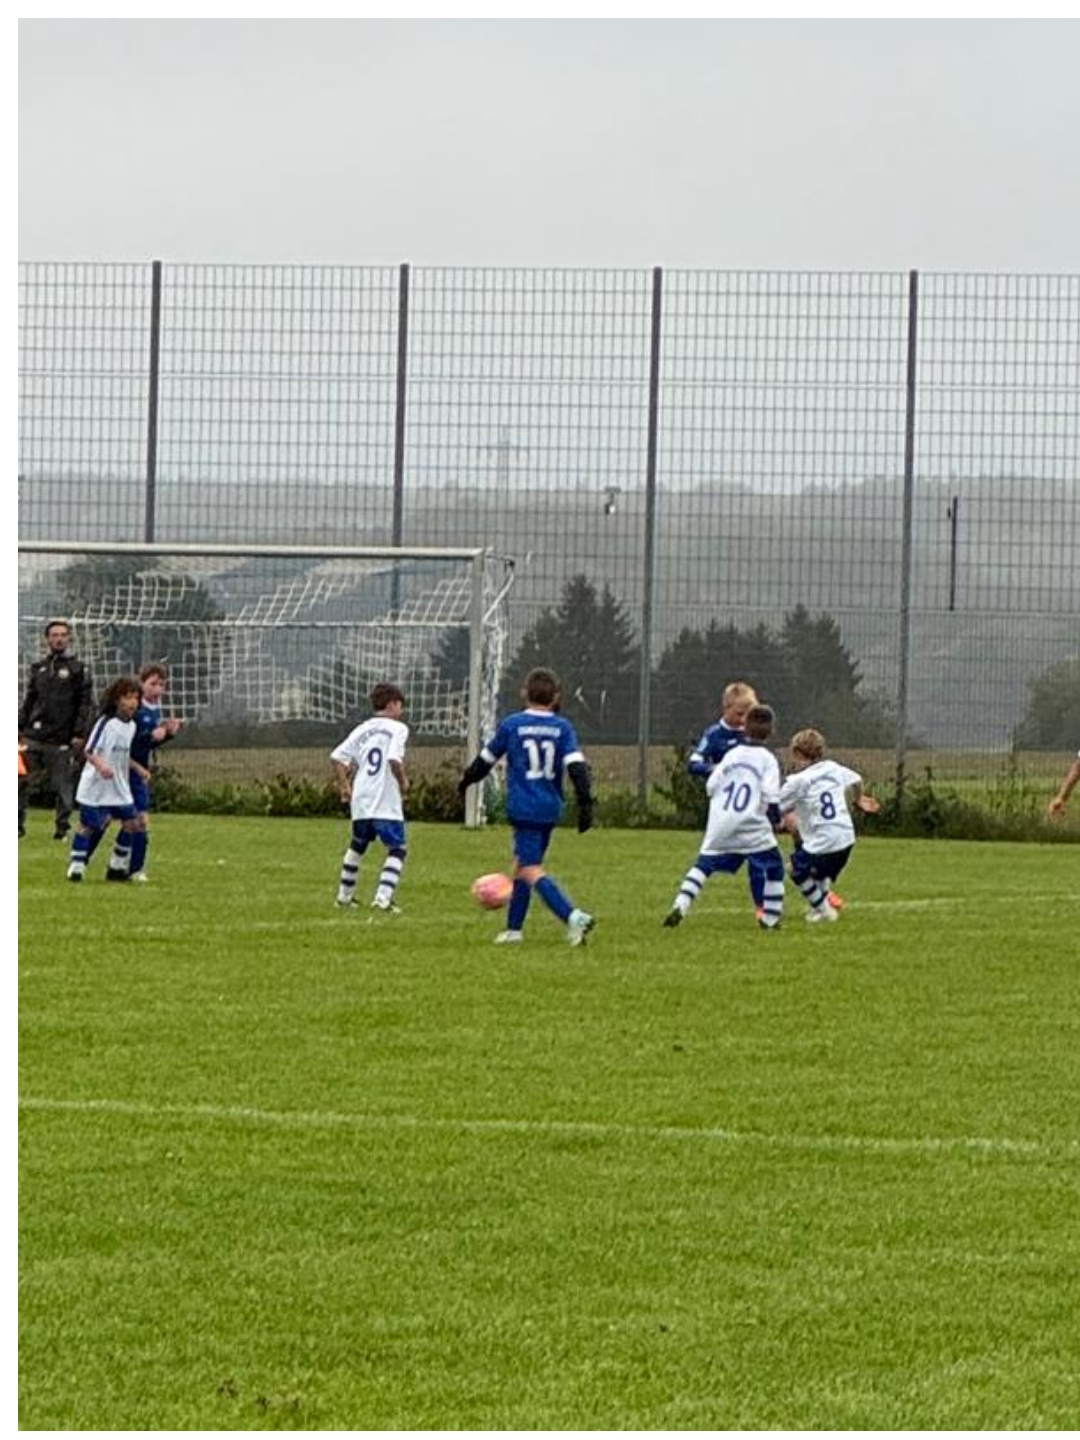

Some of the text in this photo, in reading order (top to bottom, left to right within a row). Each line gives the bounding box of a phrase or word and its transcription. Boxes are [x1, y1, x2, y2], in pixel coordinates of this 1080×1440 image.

[367, 747, 383, 776] 9
[522, 739, 556, 780] 11
[723, 780, 752, 812] 10
[820, 791, 836, 820] 8
